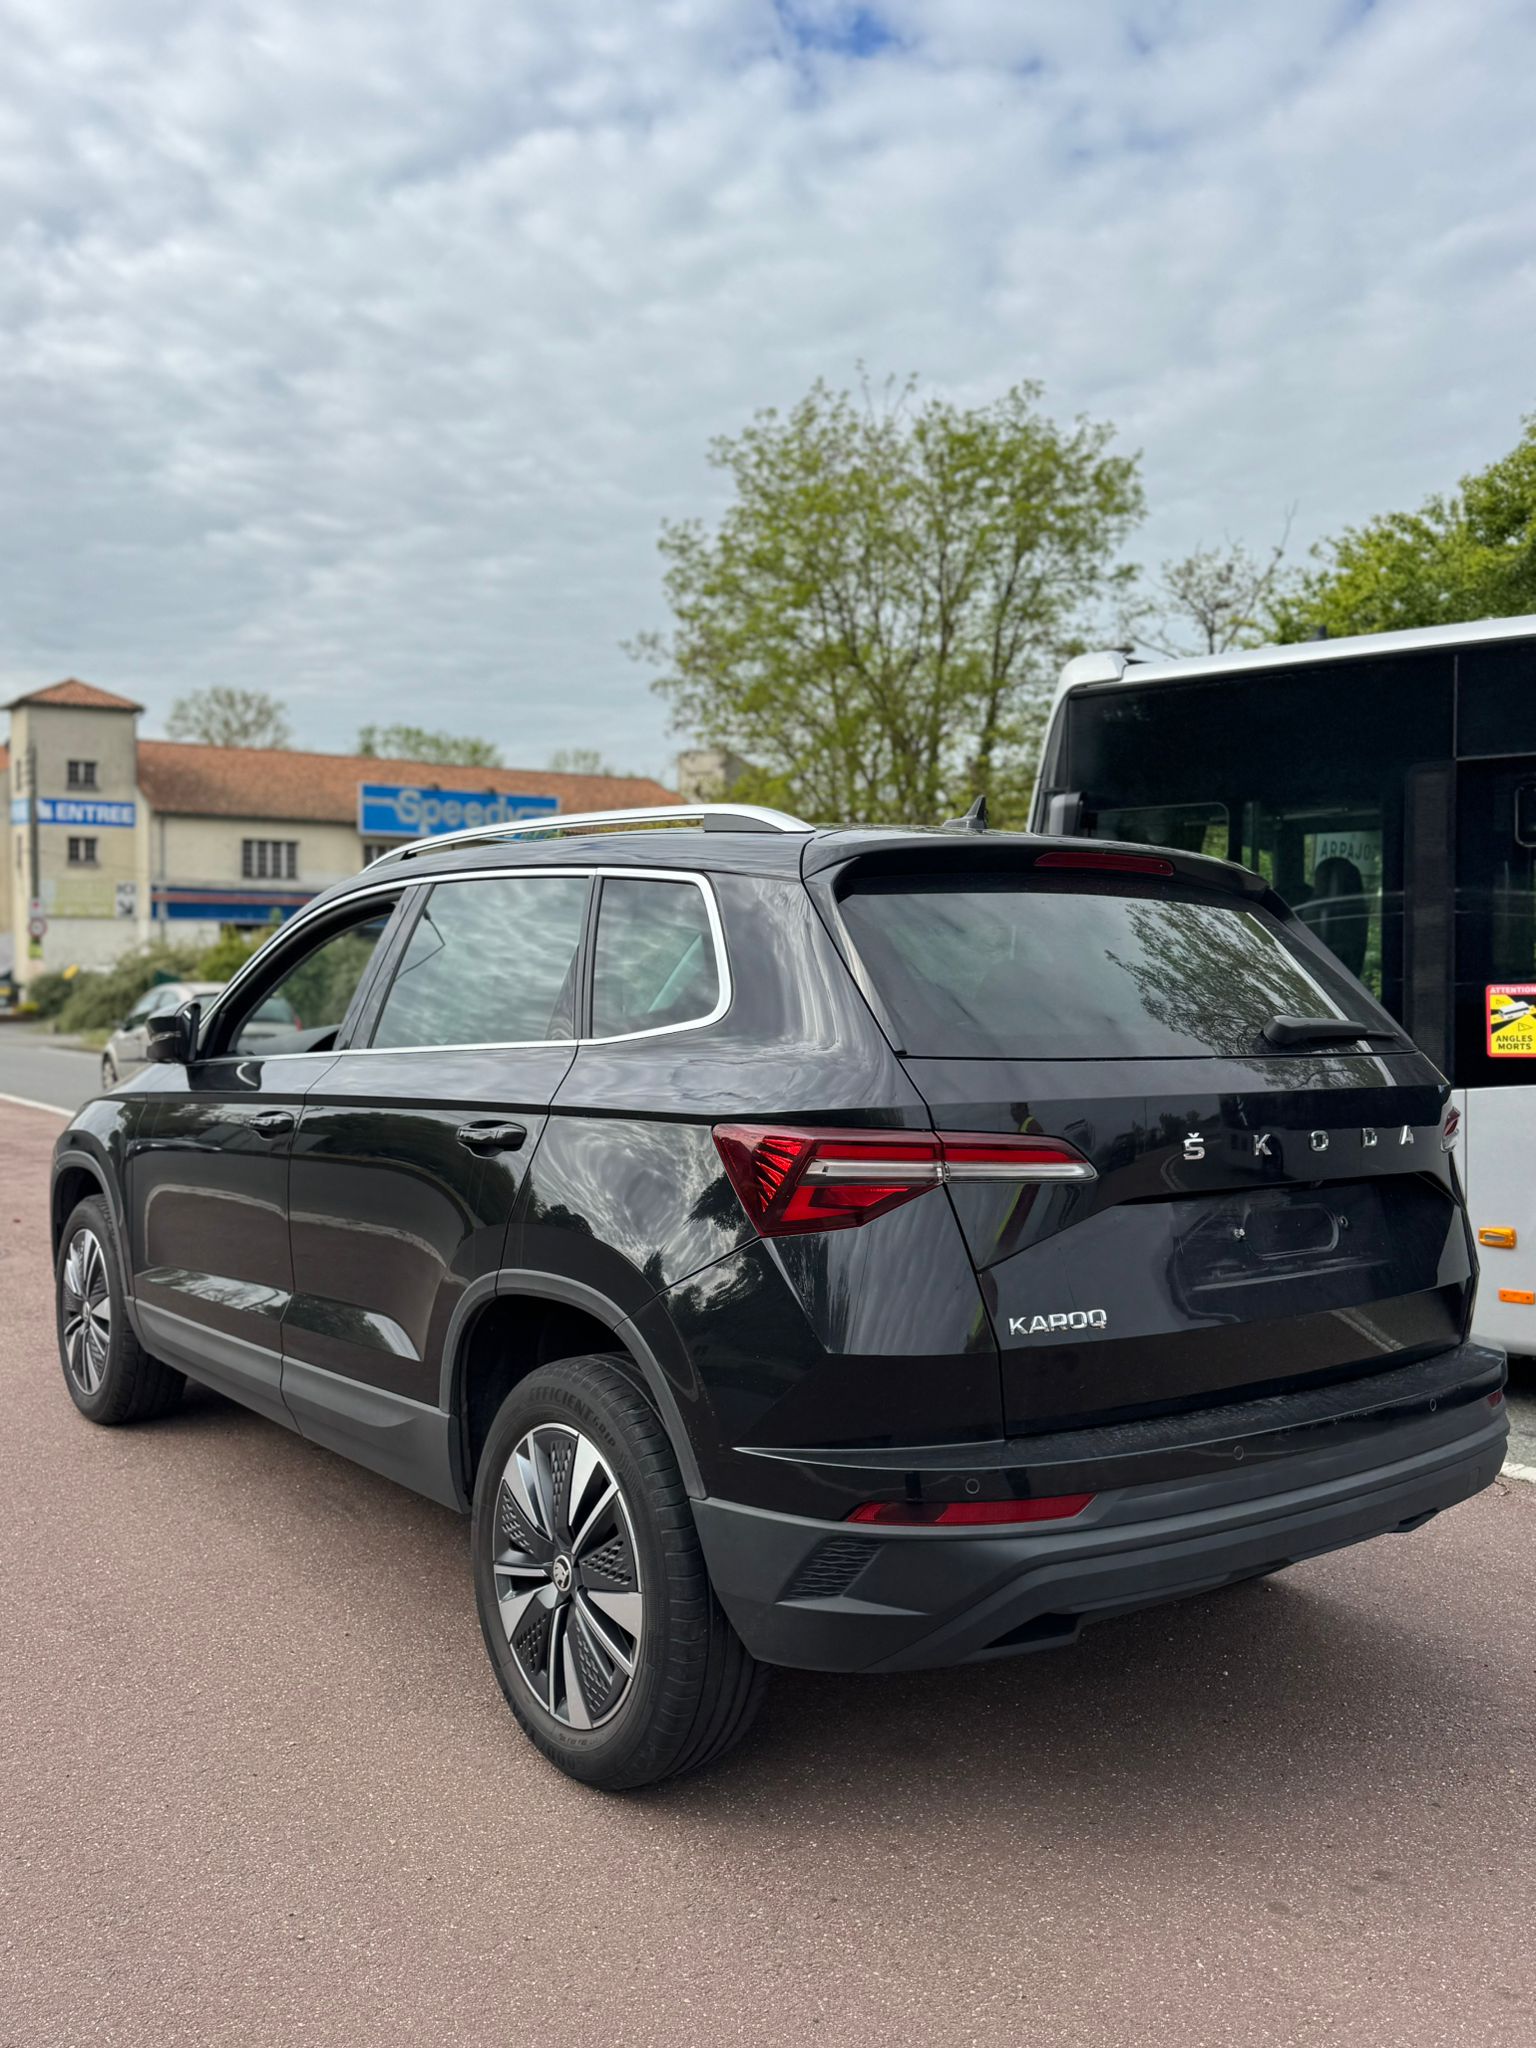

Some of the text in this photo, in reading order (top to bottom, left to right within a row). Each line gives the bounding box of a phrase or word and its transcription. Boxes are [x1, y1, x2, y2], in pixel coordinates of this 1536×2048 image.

[395, 789, 526, 834] Speedy
[1183, 1124, 1415, 1160] ŠKODA
[1009, 1309, 1108, 1336] KAROQ
